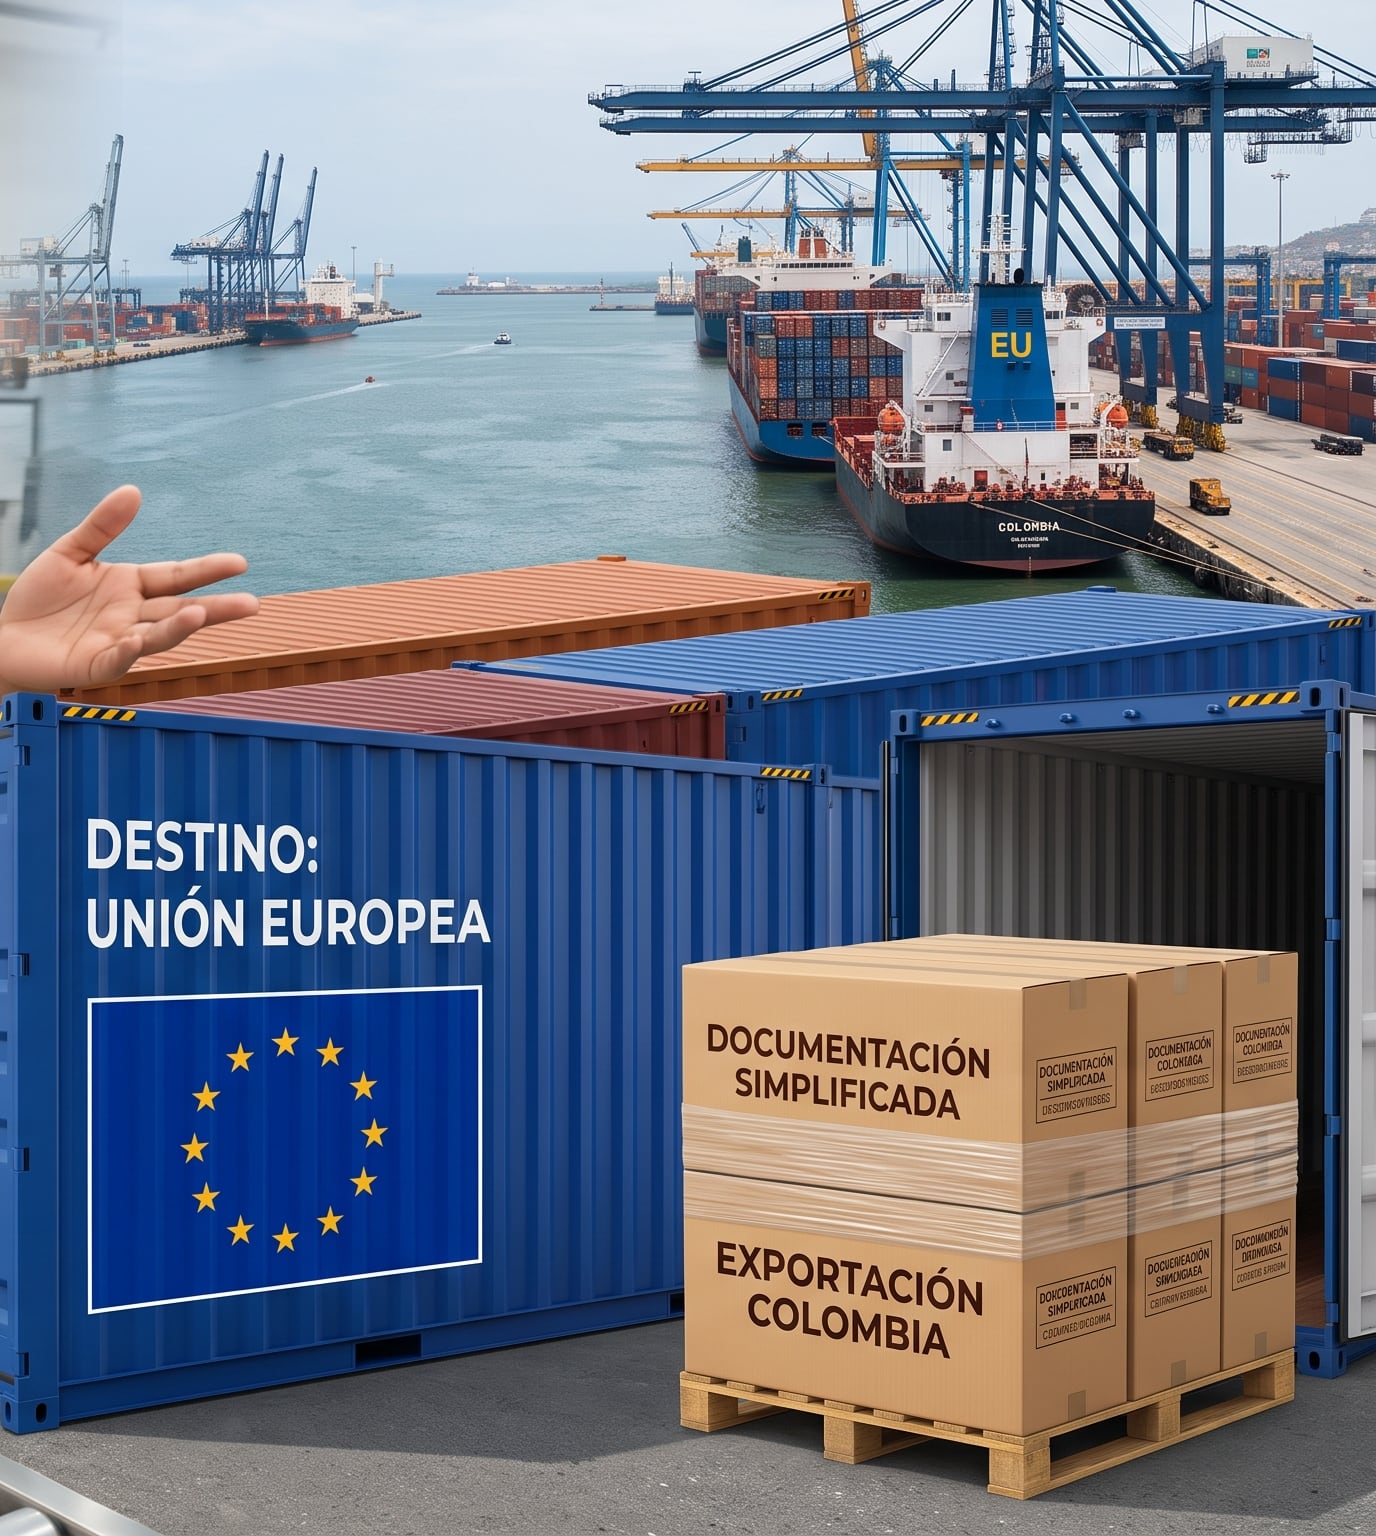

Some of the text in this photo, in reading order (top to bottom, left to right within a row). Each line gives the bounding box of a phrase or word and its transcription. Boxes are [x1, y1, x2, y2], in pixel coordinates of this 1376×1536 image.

[991, 331, 1032, 358] EU
[998, 521, 1060, 532] COLOMBIA
[87, 818, 319, 874] DESTINO:
[87, 885, 492, 949] UNIÓN EUROPEA
[707, 1023, 990, 1079] DOCUMENTACIÓN
[735, 1068, 961, 1121] SIMPLIFICADA
[717, 1240, 984, 1317] EXPORTACIÓN
[748, 1293, 951, 1359] COLOMBIA
